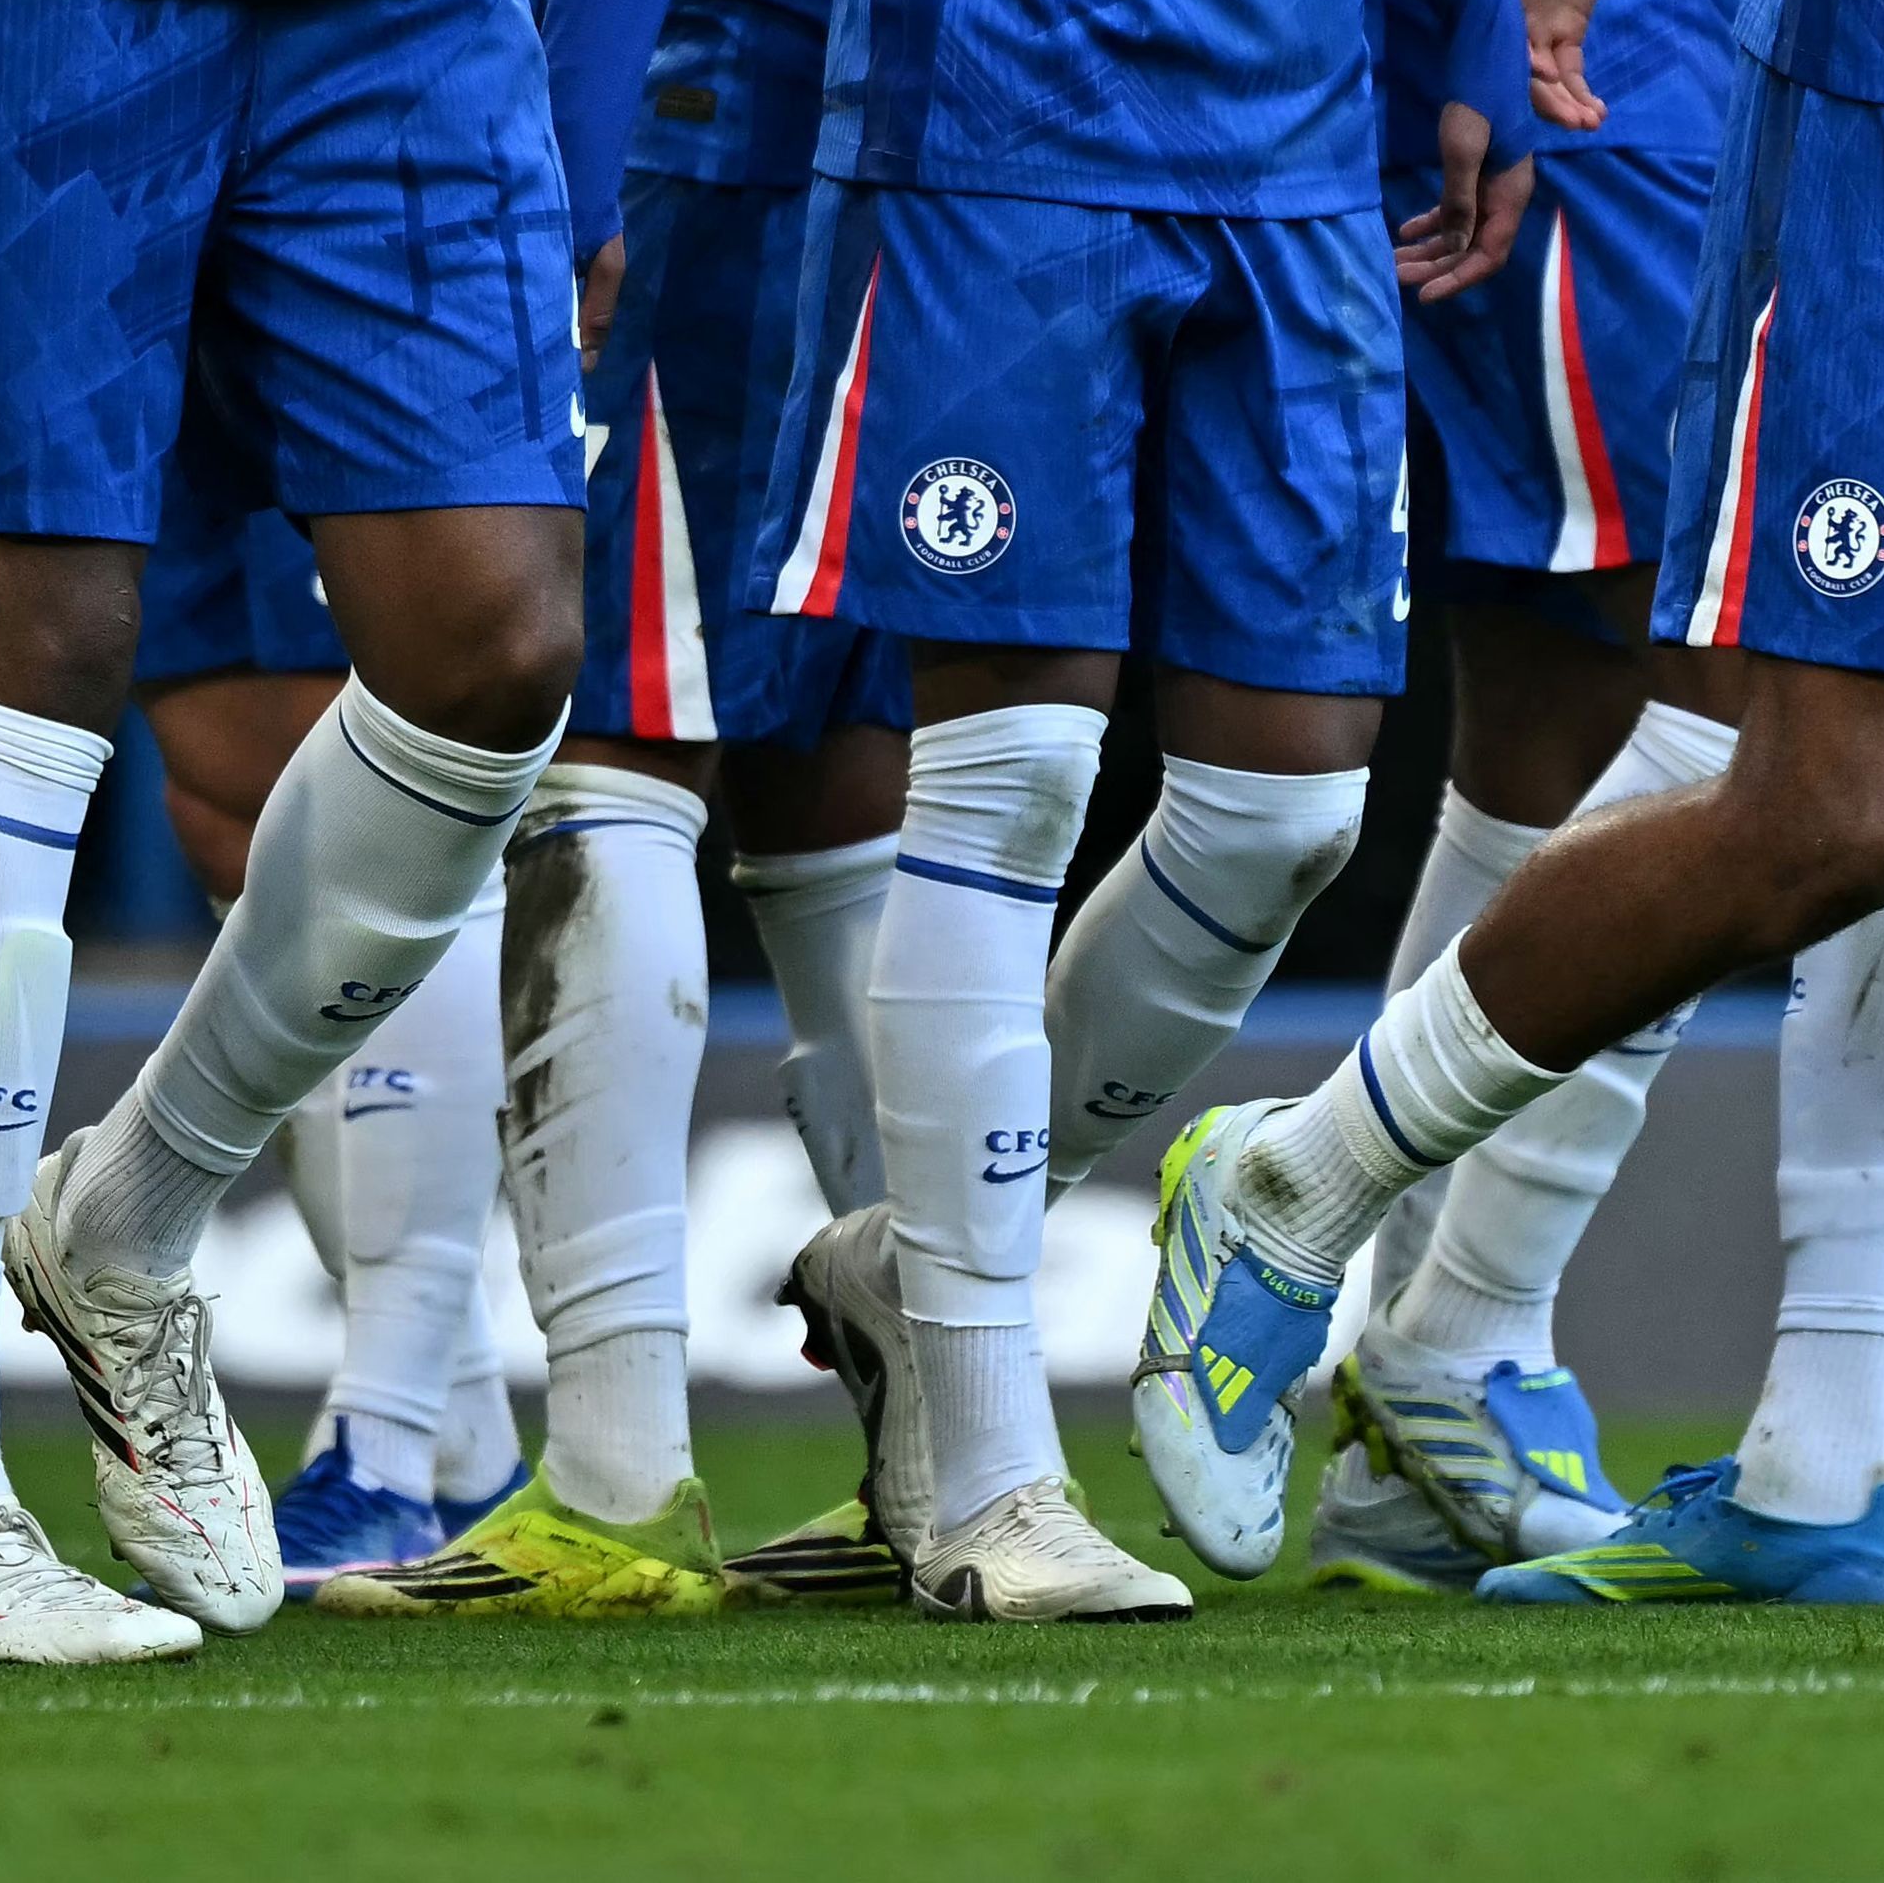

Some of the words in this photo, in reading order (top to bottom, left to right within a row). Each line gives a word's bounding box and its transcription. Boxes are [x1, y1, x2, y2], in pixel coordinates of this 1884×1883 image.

[924, 462, 998, 491] CHELSEA
[1815, 483, 1879, 512] CHELSEA
[916, 543, 963, 569] FOOTBALL
[967, 549, 992, 566] CLUB
[1806, 566, 1846, 591] FOOTBALL
[1849, 572, 1873, 589] CLUB
